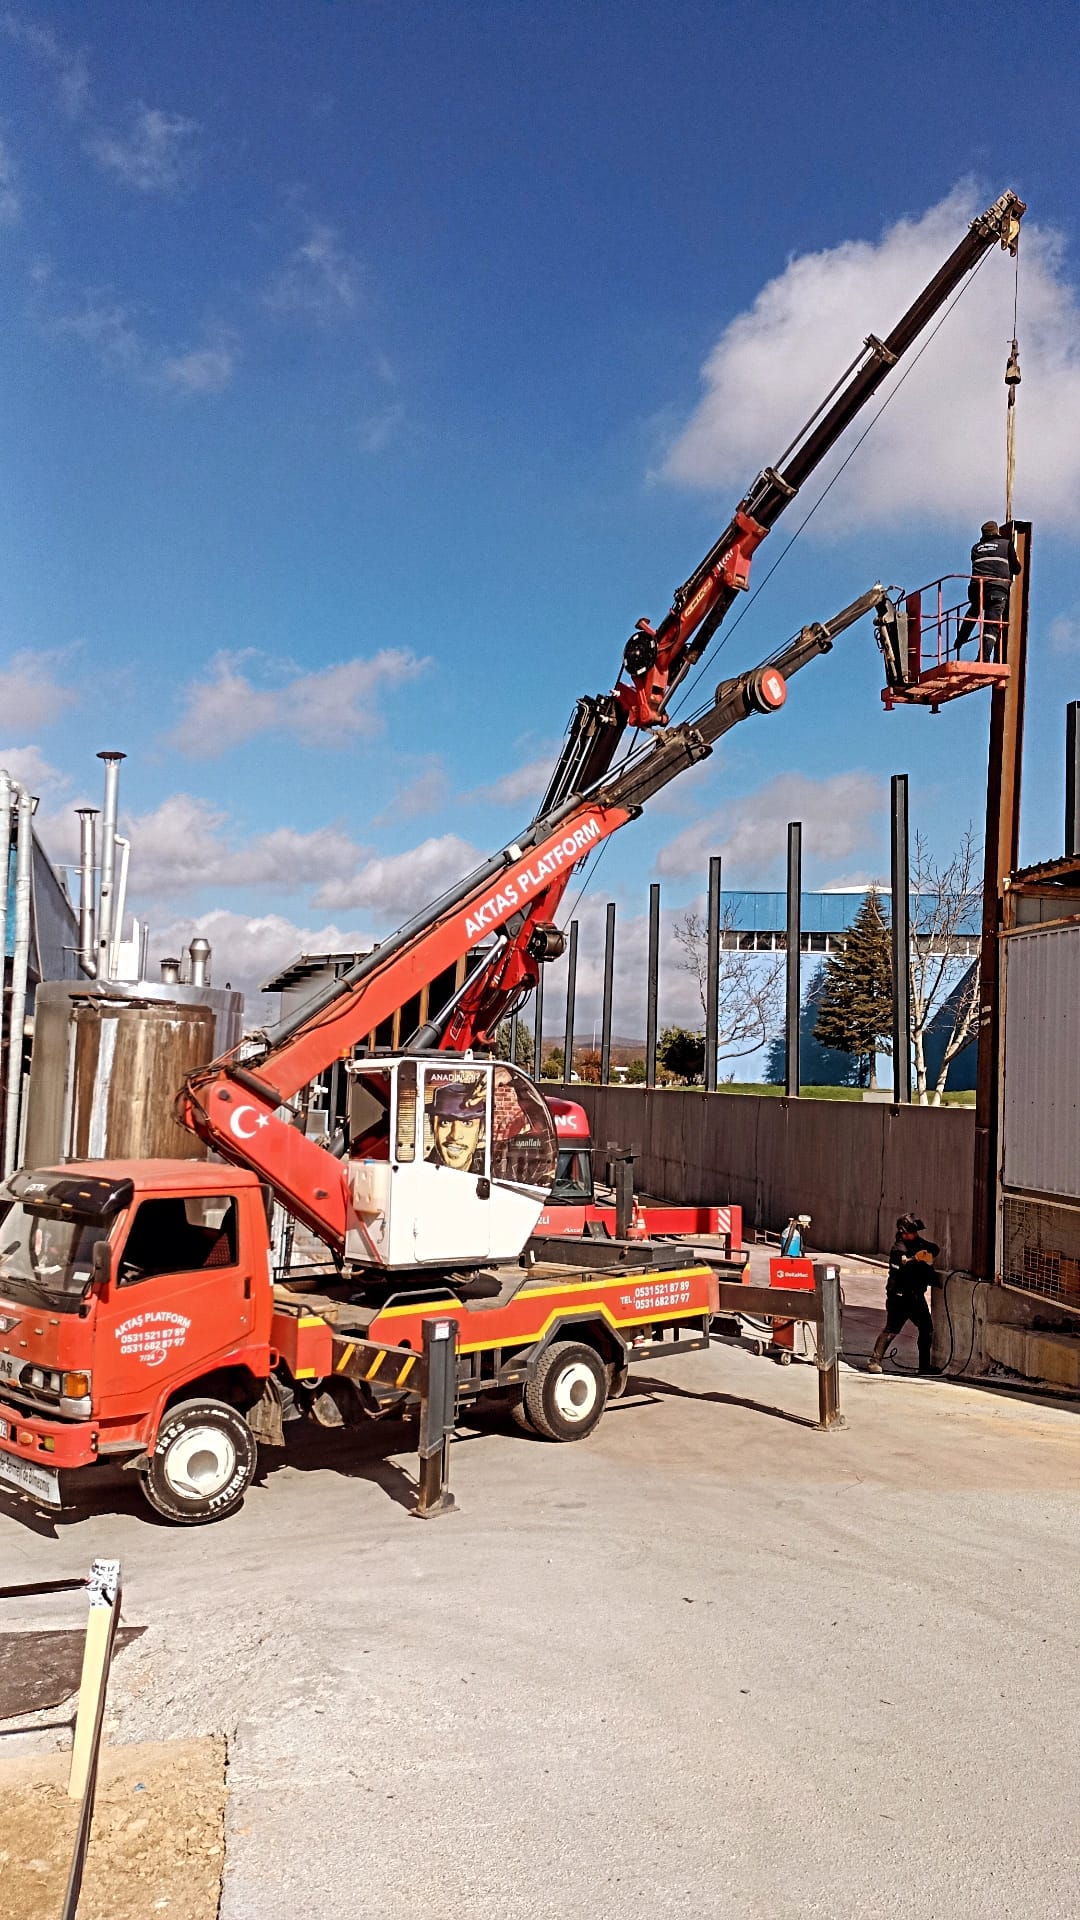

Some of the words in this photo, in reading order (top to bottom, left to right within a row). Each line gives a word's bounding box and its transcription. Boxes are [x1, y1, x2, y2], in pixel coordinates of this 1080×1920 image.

[464, 884, 519, 938] AKTAŞ
[517, 817, 601, 893] PLATFORM
[554, 1114, 577, 1130] NÇ
[635, 1286, 654, 1298] 0531
[655, 1283, 669, 1295] 521
[669, 1282, 679, 1292] 87
[680, 1280, 690, 1291] 89
[635, 1298, 654, 1310] 0531
[655, 1295, 670, 1307] 682
[670, 1294, 679, 1305] 87
[680, 1292, 690, 1303] 97
[114, 1314, 144, 1339] AKTAŞ
[144, 1311, 192, 1329] PLATFORM
[120, 1333, 144, 1344] 0531
[144, 1330, 161, 1340] 521
[162, 1328, 173, 1339] 87
[174, 1327, 186, 1337] 89
[120, 1343, 143, 1355] 0531
[143, 1340, 161, 1351] 682
[162, 1338, 173, 1349] 87
[174, 1337, 186, 1347] 97
[208, 1465, 247, 1509] PIRELLI
